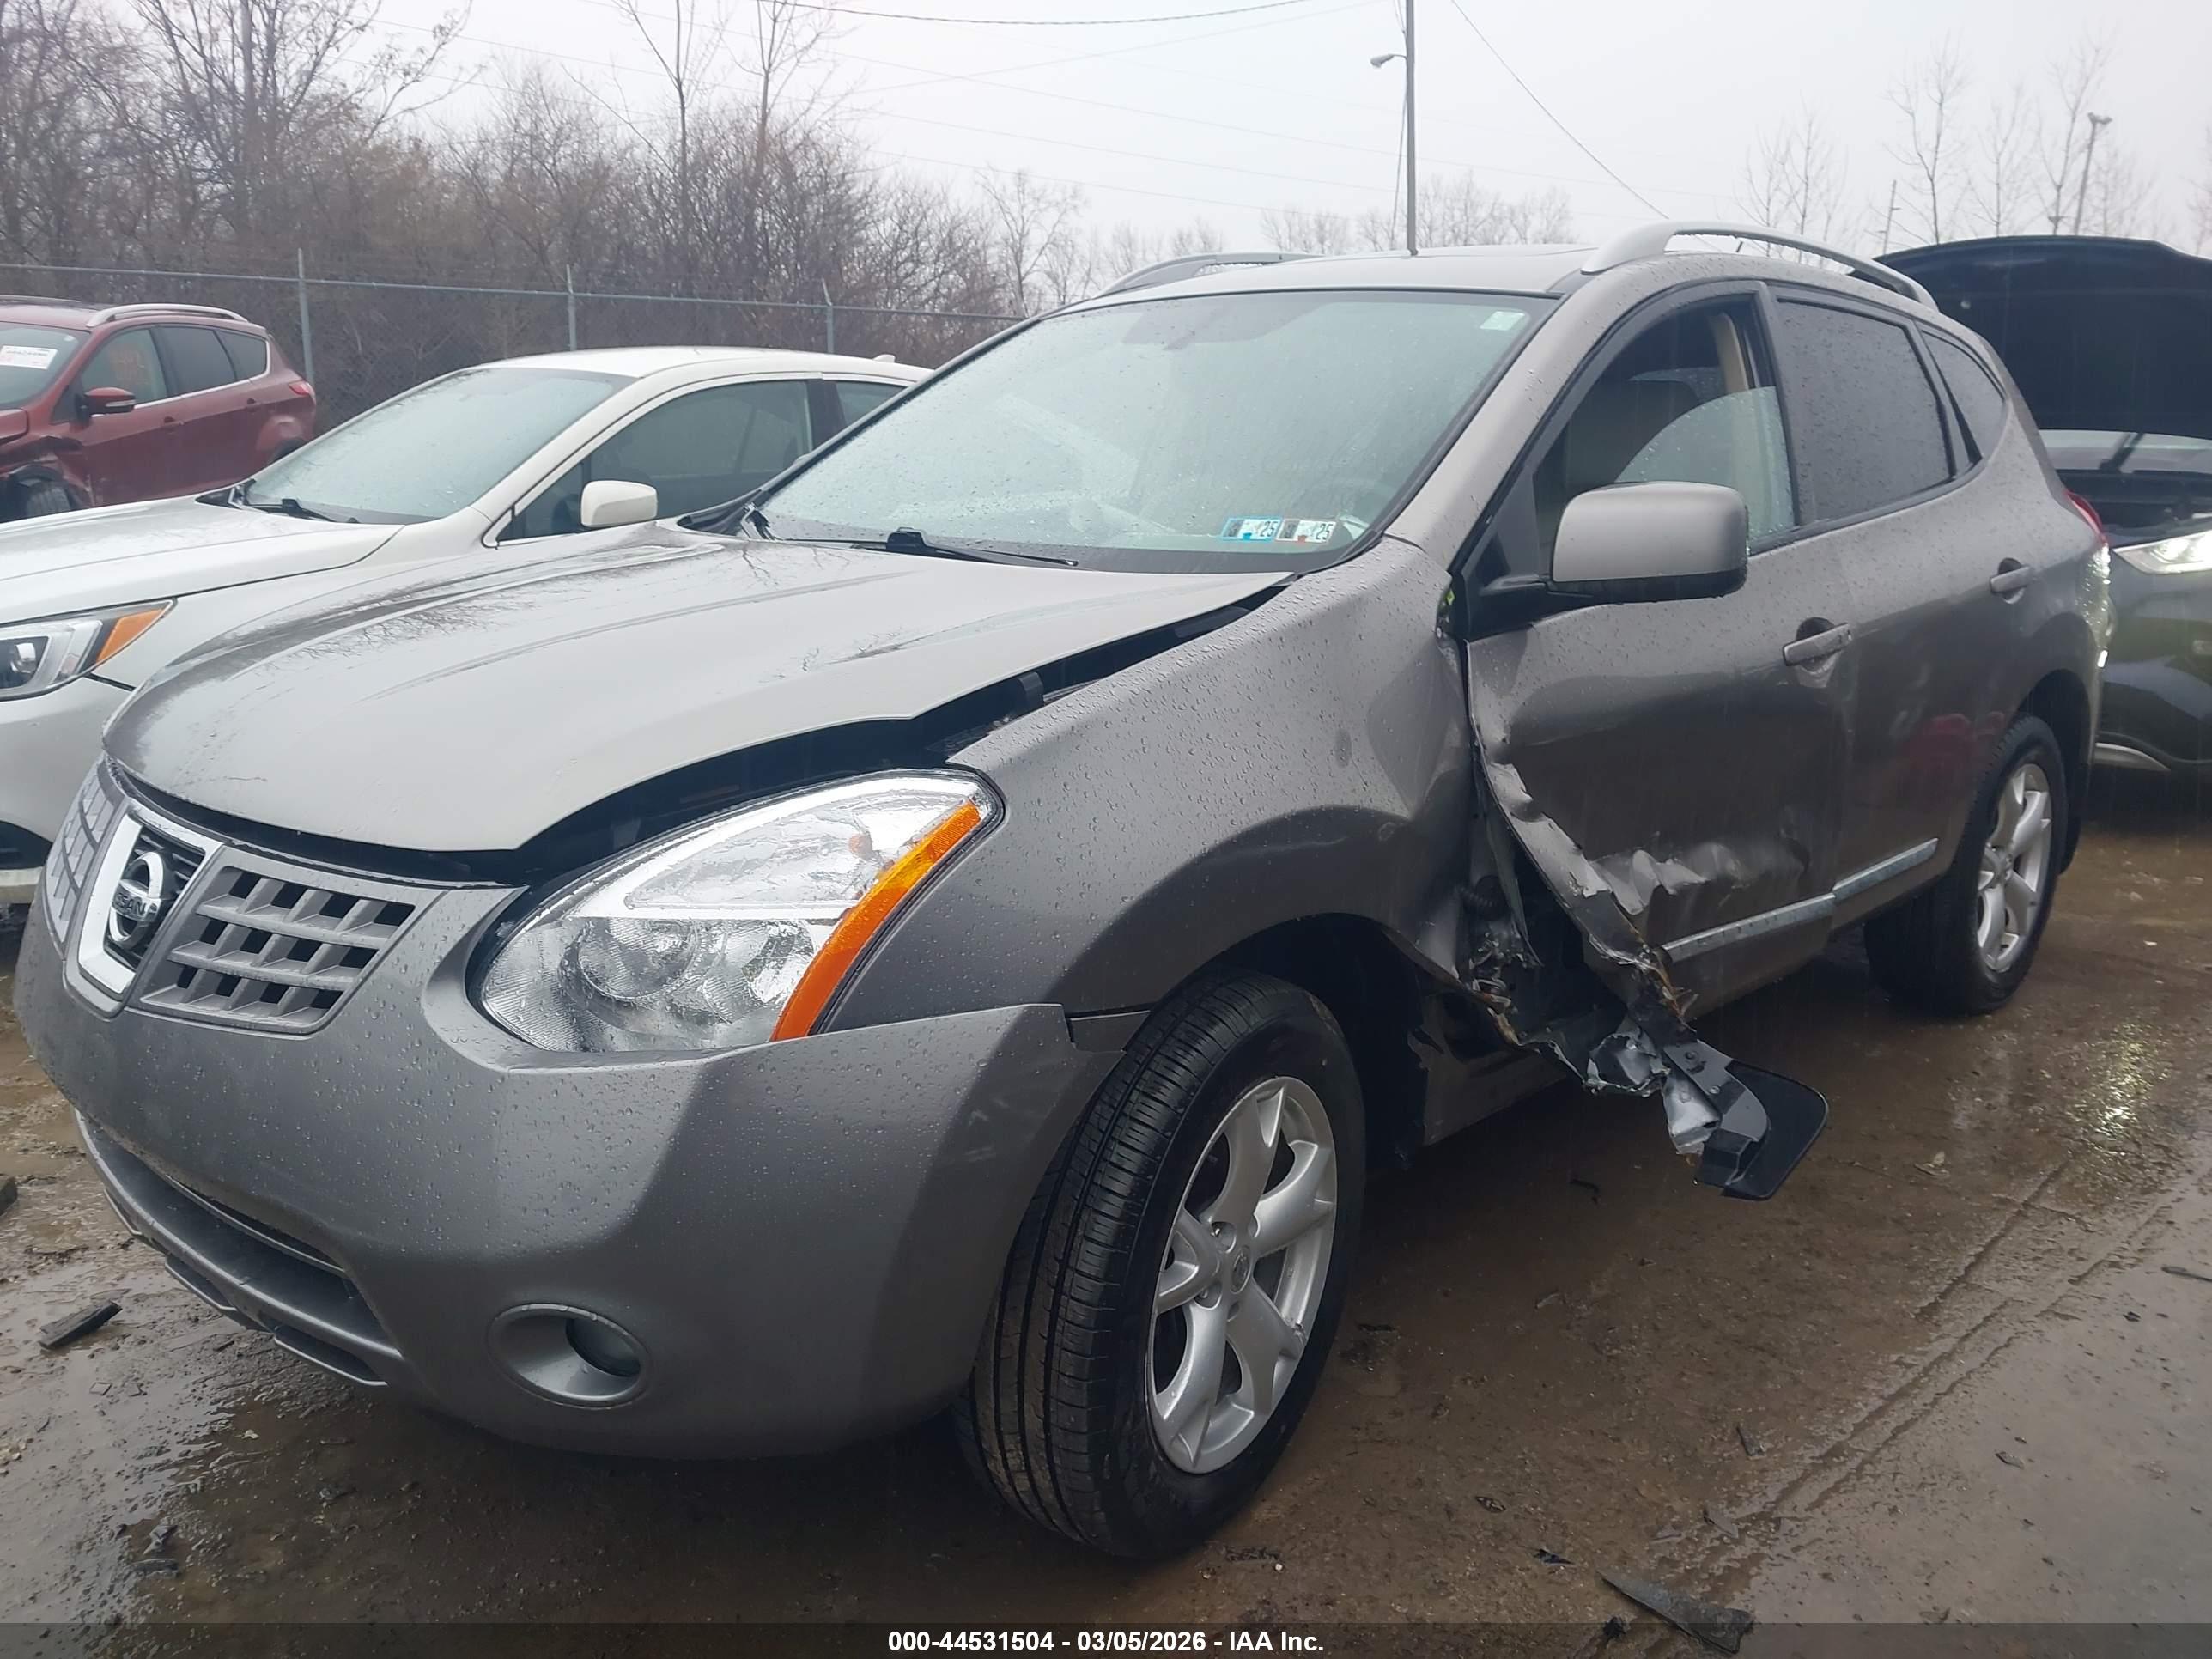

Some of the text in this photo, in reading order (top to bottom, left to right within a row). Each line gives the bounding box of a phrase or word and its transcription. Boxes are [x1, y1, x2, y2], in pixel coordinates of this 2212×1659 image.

[1259, 520, 1279, 538] 25
[1315, 522, 1334, 541] 25
[114, 891, 148, 917] SSAN
